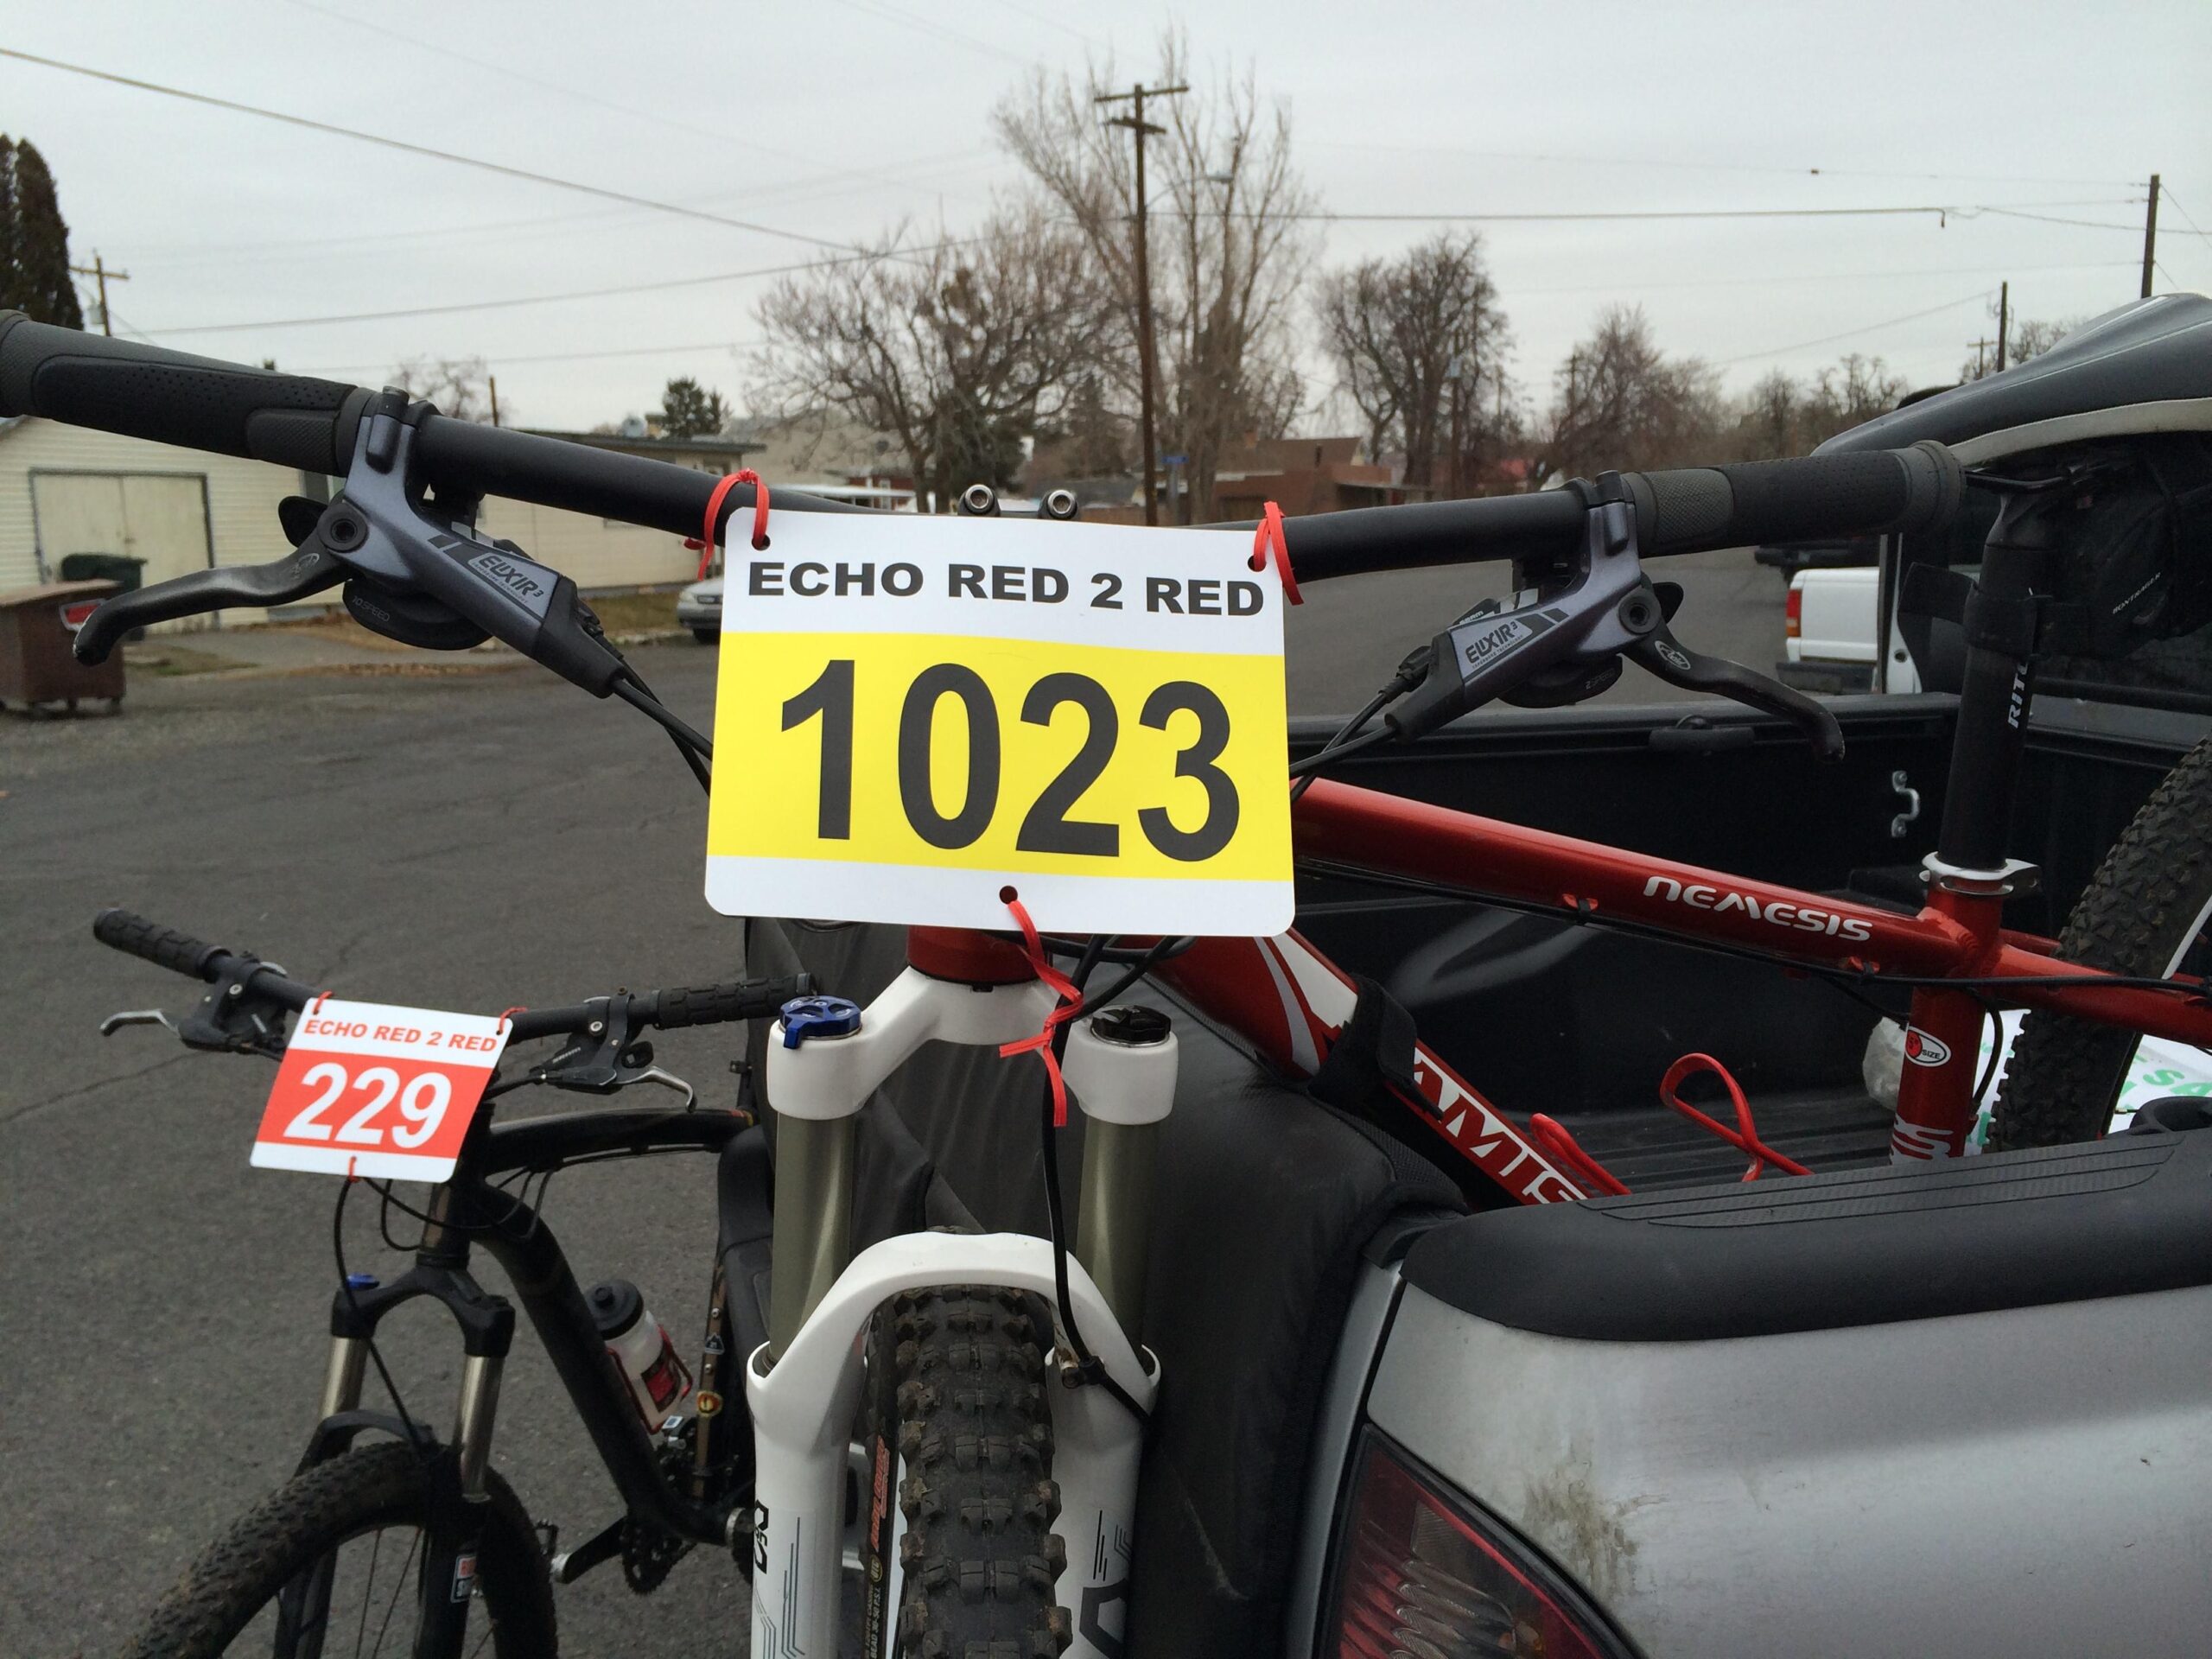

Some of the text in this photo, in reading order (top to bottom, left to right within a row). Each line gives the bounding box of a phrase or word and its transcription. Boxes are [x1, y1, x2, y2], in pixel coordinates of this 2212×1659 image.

[479, 556, 538, 596] ELIXIR
[748, 562, 1264, 616] ECHO RED 2 RED
[1465, 624, 1515, 664] ELIXIR
[781, 659, 1240, 862] 1023
[1643, 875, 1873, 942] NEMESIS
[304, 1019, 497, 1052] ECHO RED 2 RED
[283, 1062, 452, 1148] 229
